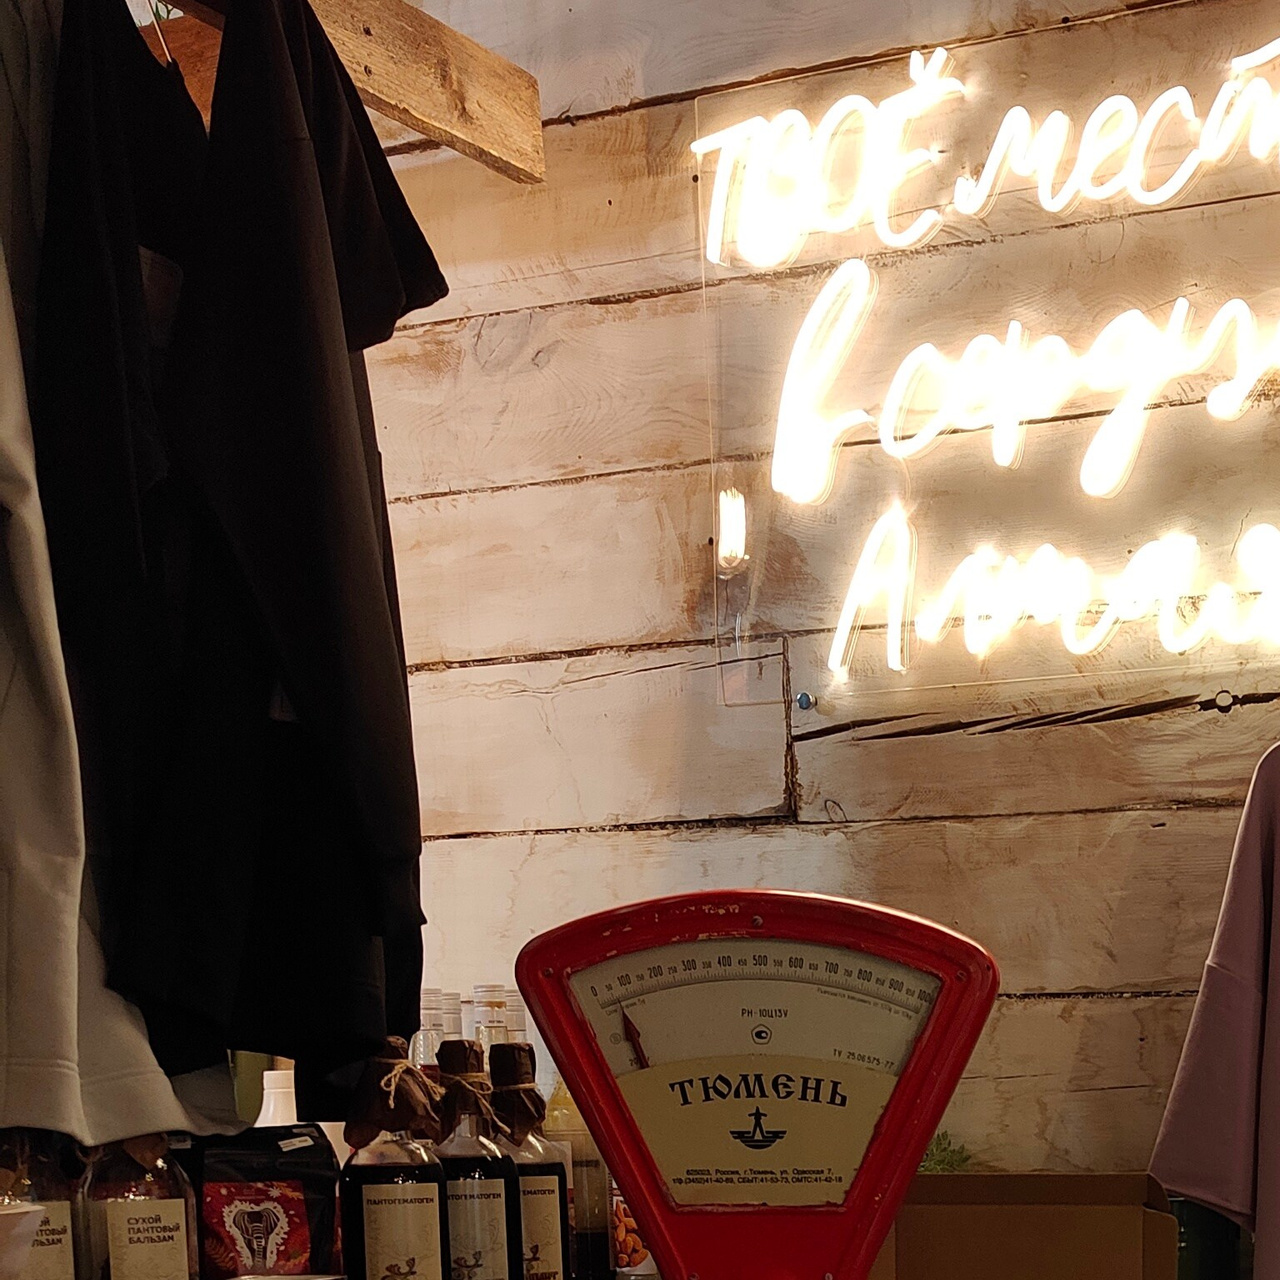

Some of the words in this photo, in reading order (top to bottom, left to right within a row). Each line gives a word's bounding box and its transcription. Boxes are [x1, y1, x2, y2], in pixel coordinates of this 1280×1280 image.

[590, 985, 598, 997] 0
[616, 973, 632, 988] 100
[647, 965, 664, 979] 200
[681, 958, 697, 972] 300
[717, 956, 732, 967] 400
[752, 954, 768, 967] 500
[788, 956, 804, 970] 600
[824, 961, 839, 975] 700
[856, 968, 872, 983] 800
[888, 978, 904, 993] 900
[668, 1073, 848, 1108] ТЮМЕНЬ
[448, 1192, 502, 1201] ТОГЕМАТОГЕН
[522, 1188, 556, 1197] ЕМАТОГЕН
[366, 1197, 435, 1206] ПАНТОГЕМАТОГЕН
[127, 1214, 162, 1226] СУХОЙ
[36, 1226, 68, 1237] ТОВЫЙ
[128, 1223, 182, 1235] ПАНТОВЫЙ
[31, 1238, 63, 1248] ЛЬЗАМ
[128, 1234, 176, 1245] БАЛЬЗАМ
